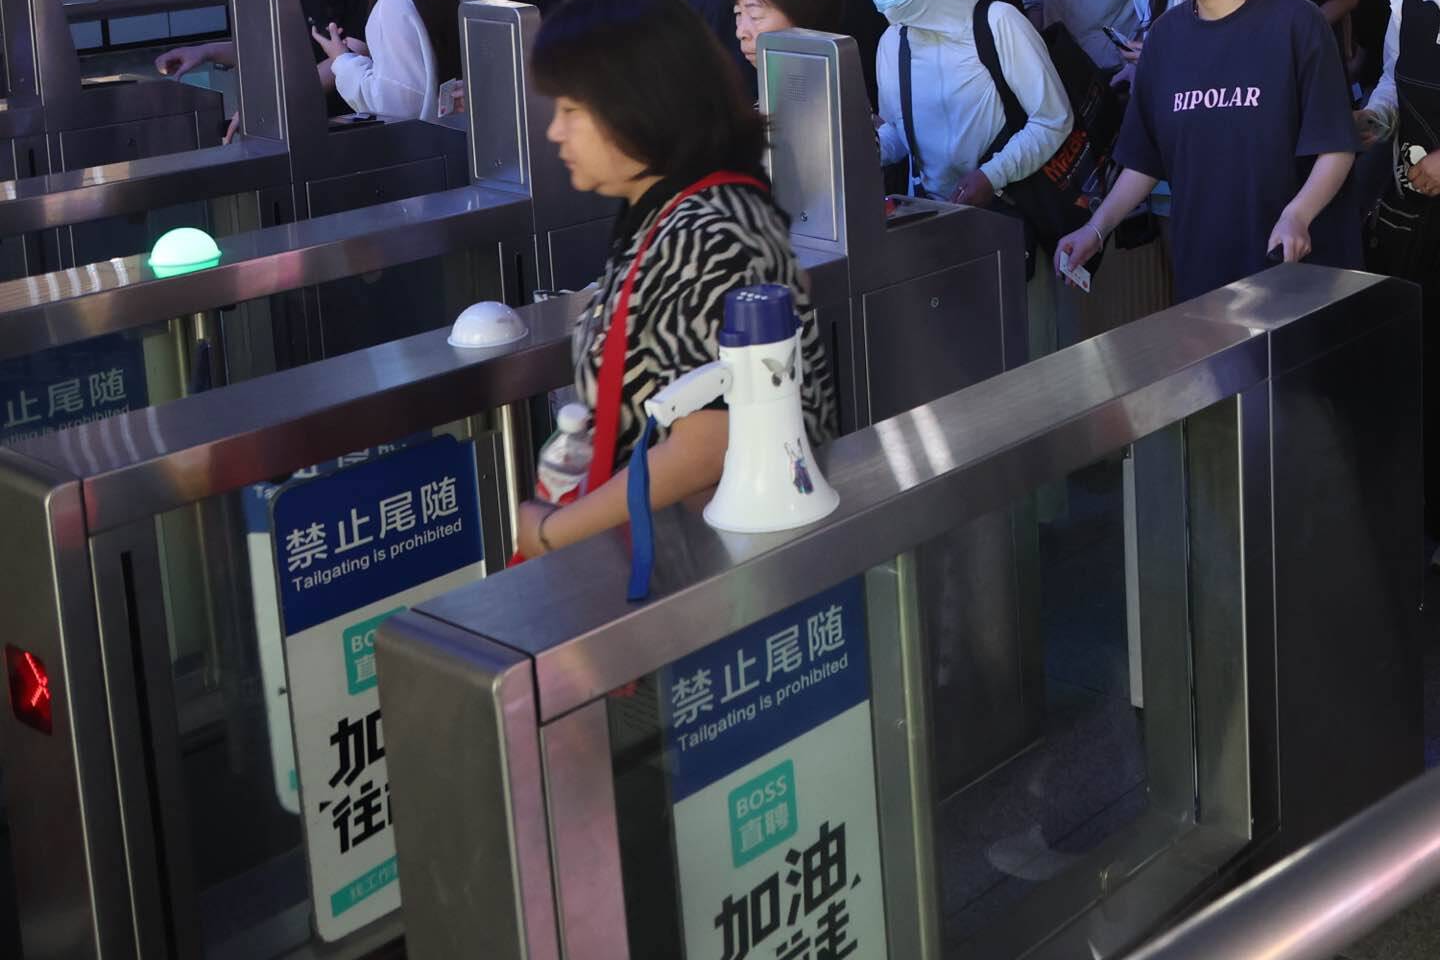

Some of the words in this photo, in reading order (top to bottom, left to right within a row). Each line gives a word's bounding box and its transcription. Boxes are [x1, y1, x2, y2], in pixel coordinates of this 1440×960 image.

[1173, 86, 1260, 112] BIPOLAR
[4, 367, 126, 428] 止尾随
[286, 476, 459, 573] 禁止尾随
[291, 555, 370, 592] Tailgating
[374, 547, 386, 563] is
[390, 518, 463, 559] prohibited
[671, 604, 846, 729] 禁止尾随
[677, 704, 756, 752] Tailgating
[759, 694, 773, 711] is
[776, 652, 849, 706] prohibited
[736, 775, 788, 819] BOSS
[739, 801, 789, 853] 直聘
[714, 820, 848, 960] 加油
